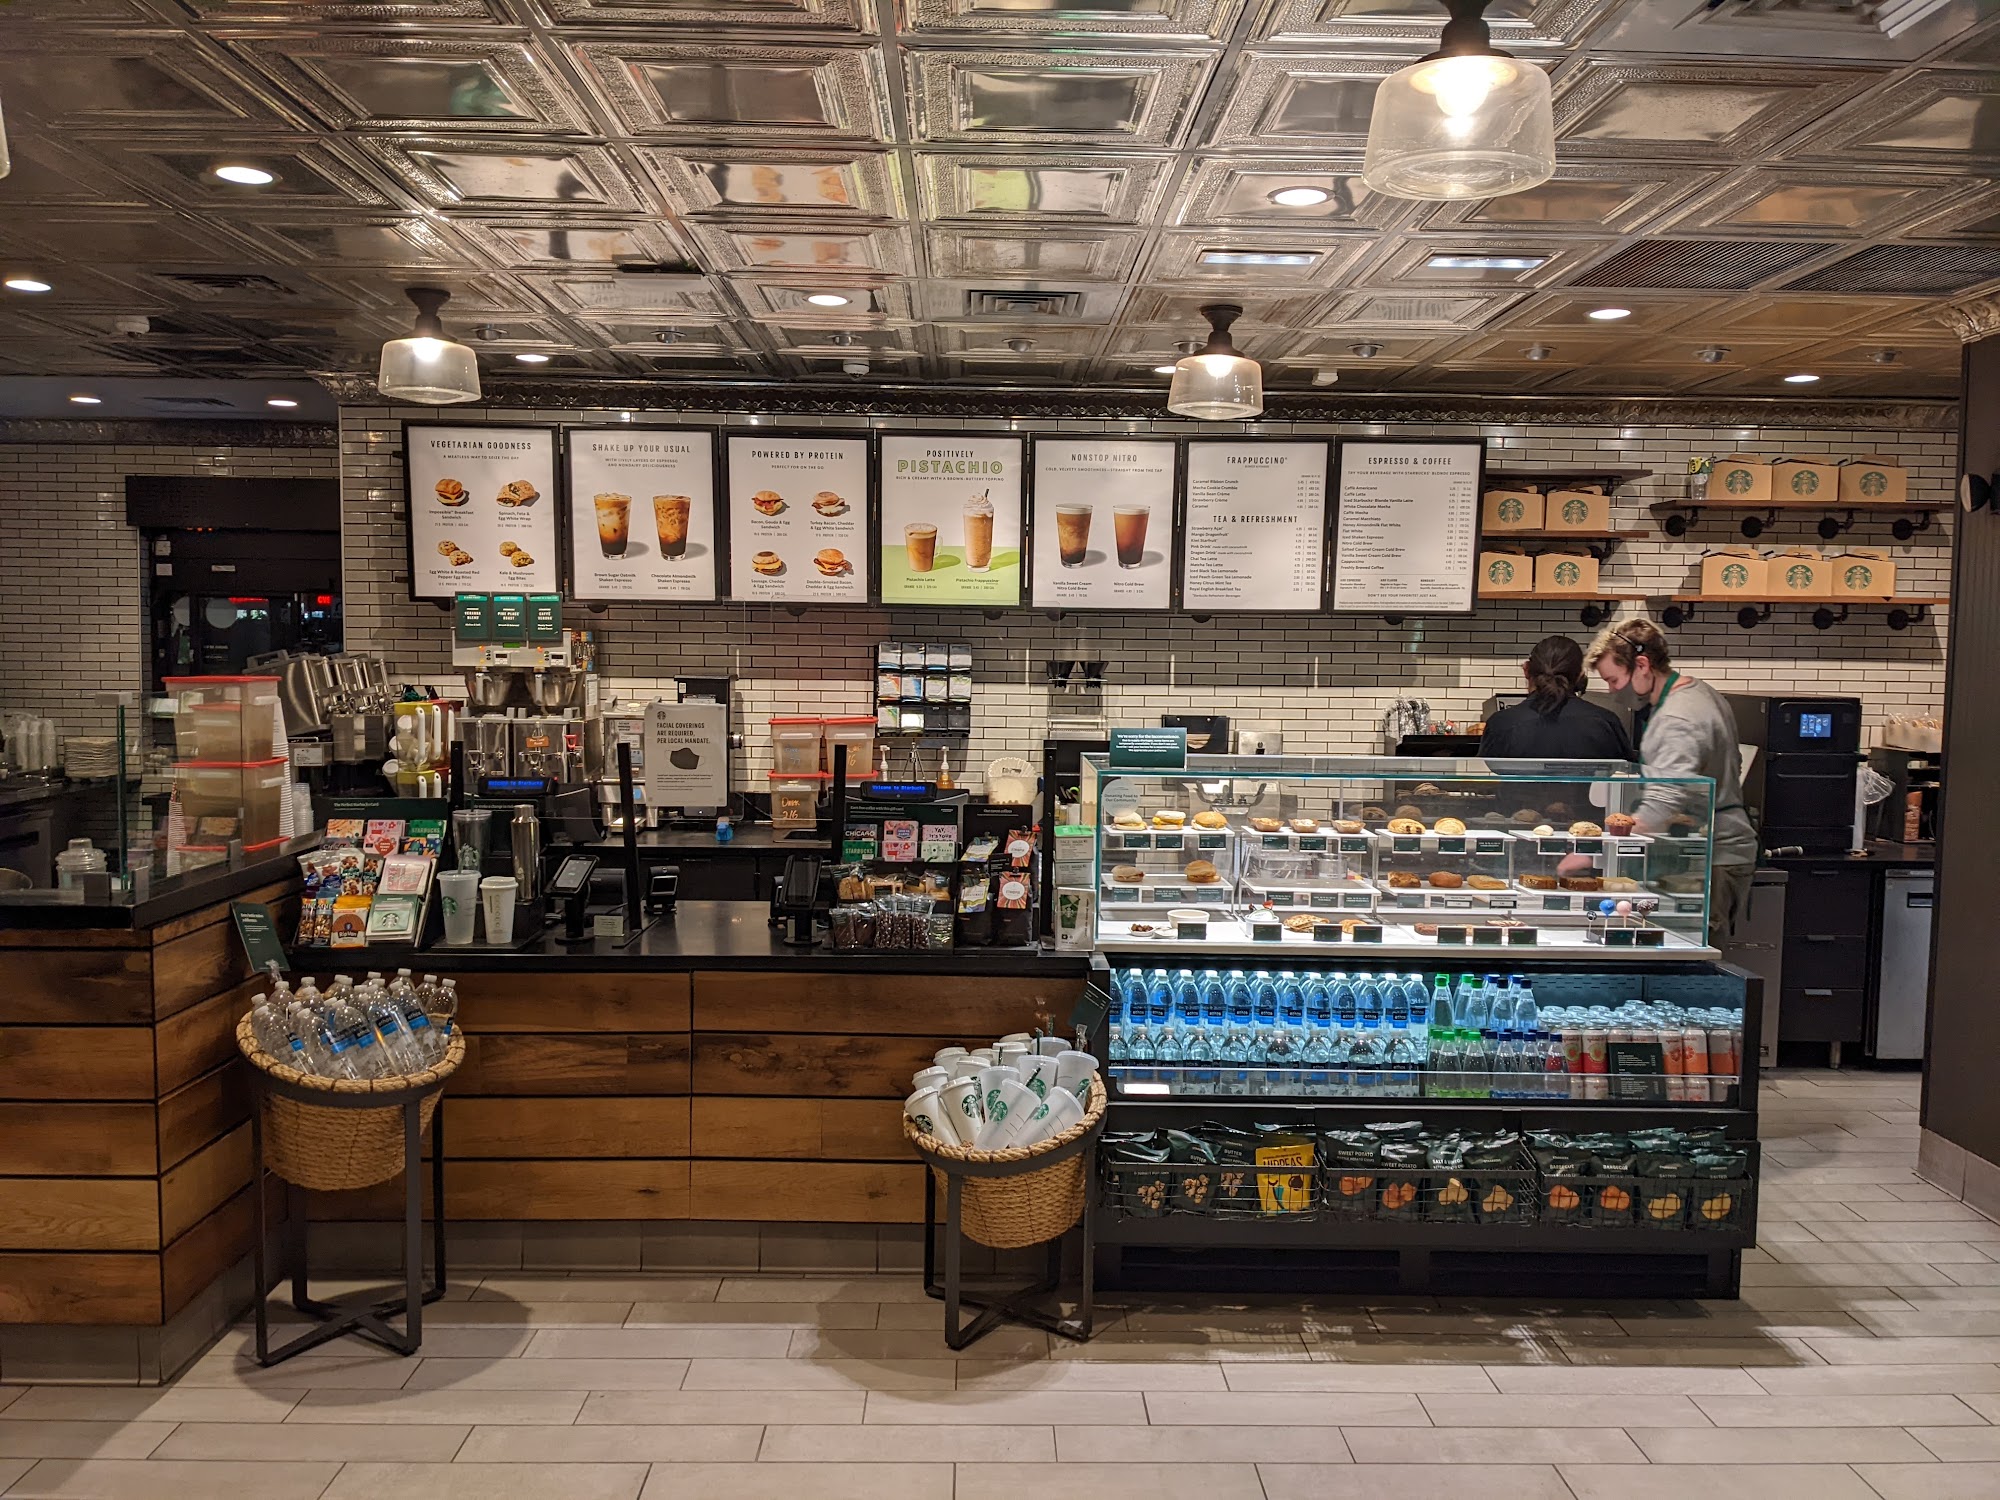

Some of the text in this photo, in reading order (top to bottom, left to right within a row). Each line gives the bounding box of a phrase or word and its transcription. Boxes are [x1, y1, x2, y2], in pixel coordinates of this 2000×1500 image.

[430, 440, 532, 450] VEGETARIAN GOODNESS
[592, 443, 691, 453] SHAKE UP YOUR USUAL
[751, 450, 790, 459] POWERED
[808, 452, 844, 460] PROTEIN
[926, 450, 974, 458] POSITIVELY
[1071, 453, 1138, 462] NONSTOP NITRO
[1368, 457, 1409, 465] ESPRESSO
[897, 459, 1003, 474] PISTACHIO
